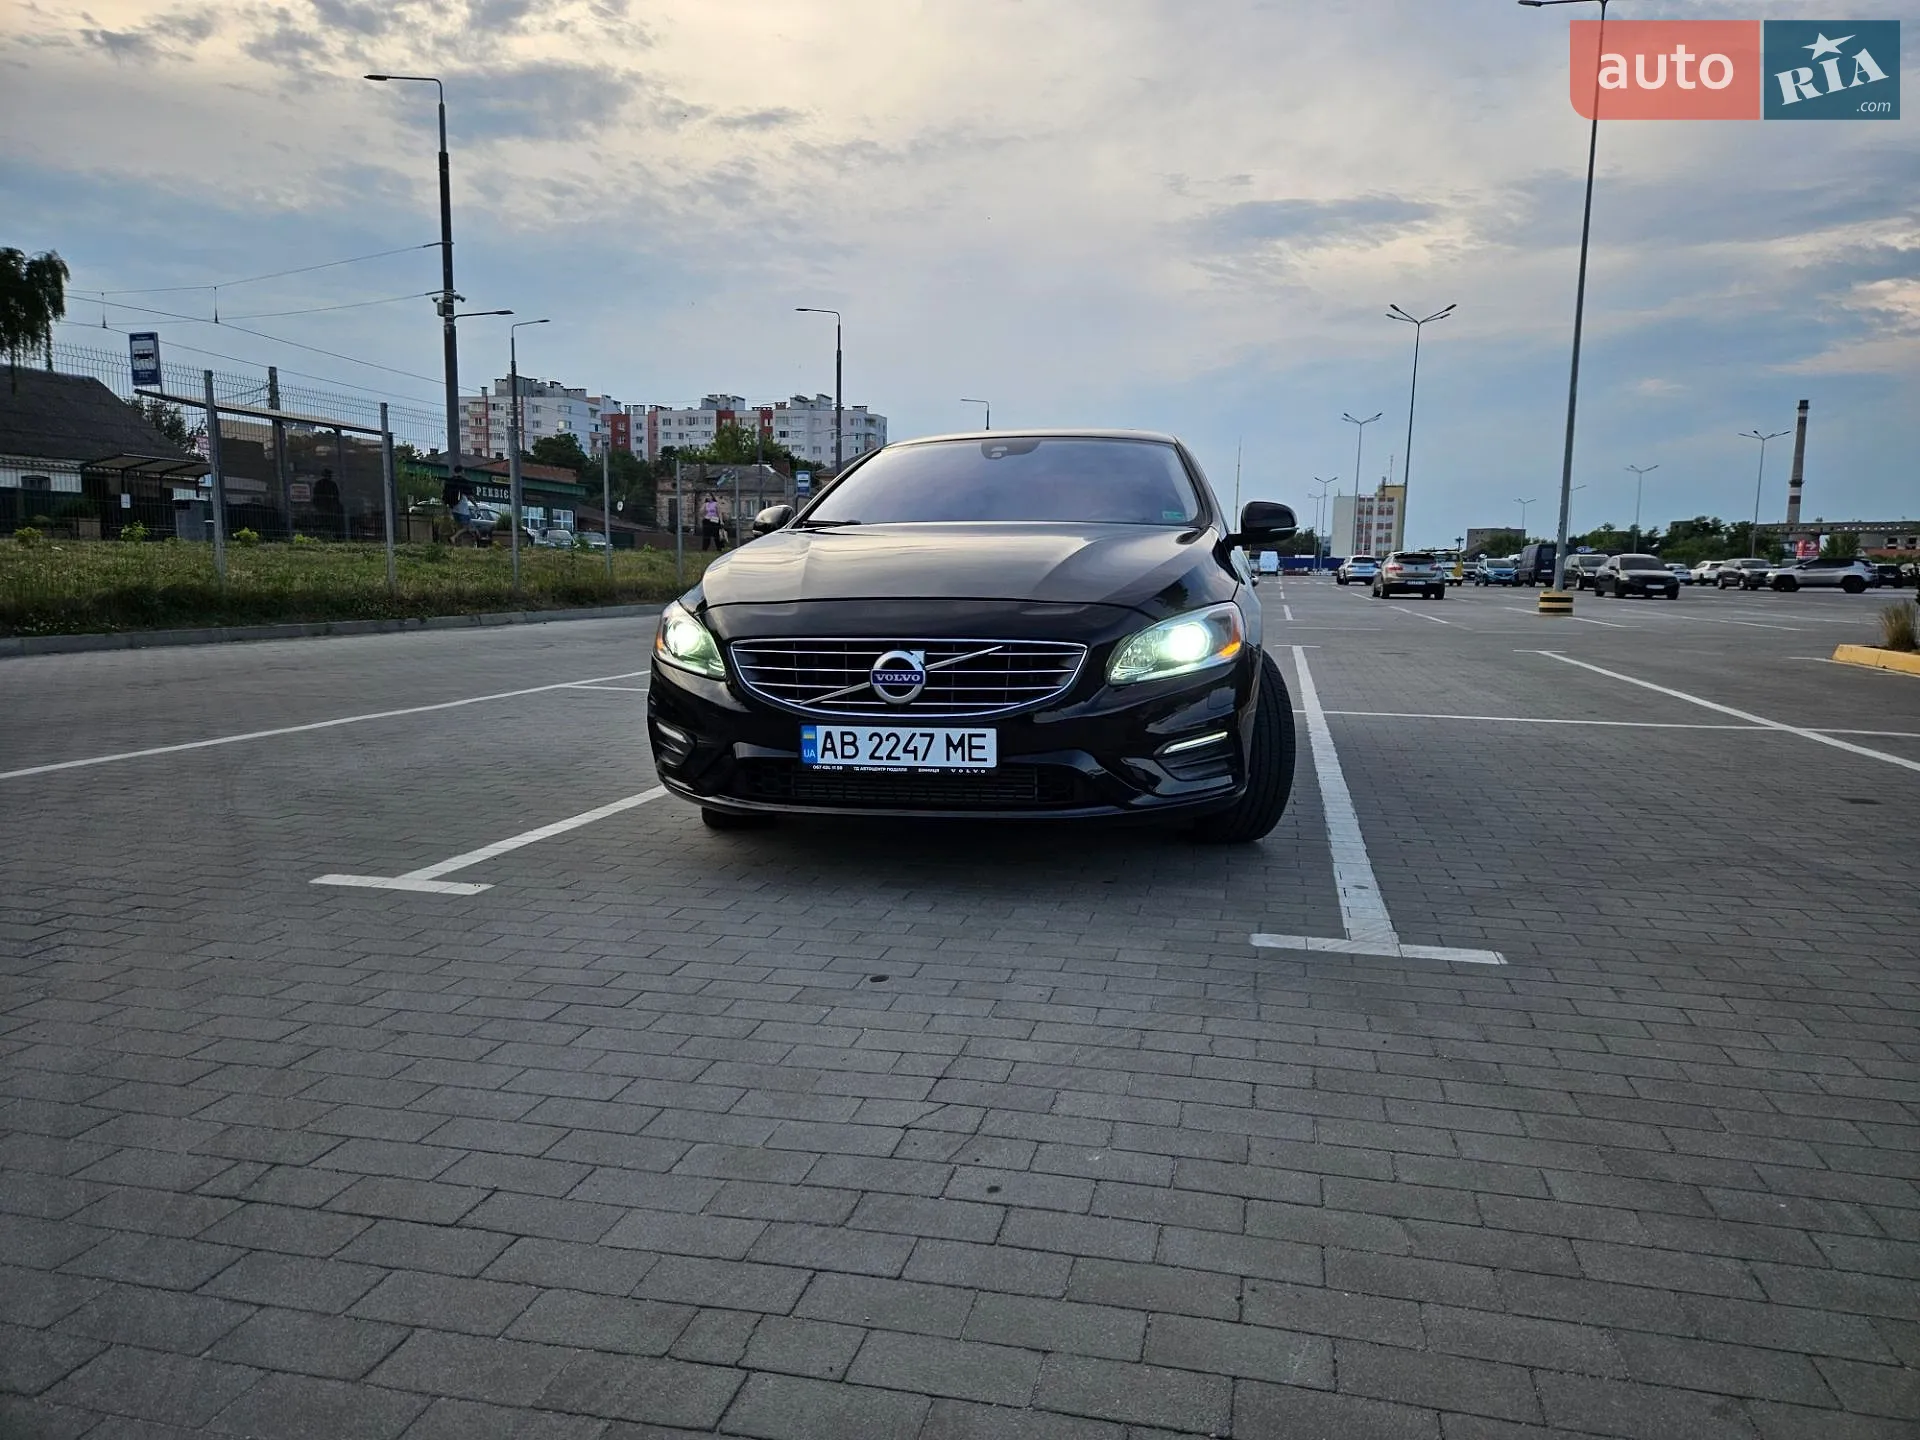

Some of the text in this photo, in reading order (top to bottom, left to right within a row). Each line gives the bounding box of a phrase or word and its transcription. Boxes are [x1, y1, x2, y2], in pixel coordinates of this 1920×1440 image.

[476, 486, 512, 500] РЕКВІЄ
[875, 673, 921, 682] VOLVO
[803, 731, 988, 762] UA AB 2247 ME
